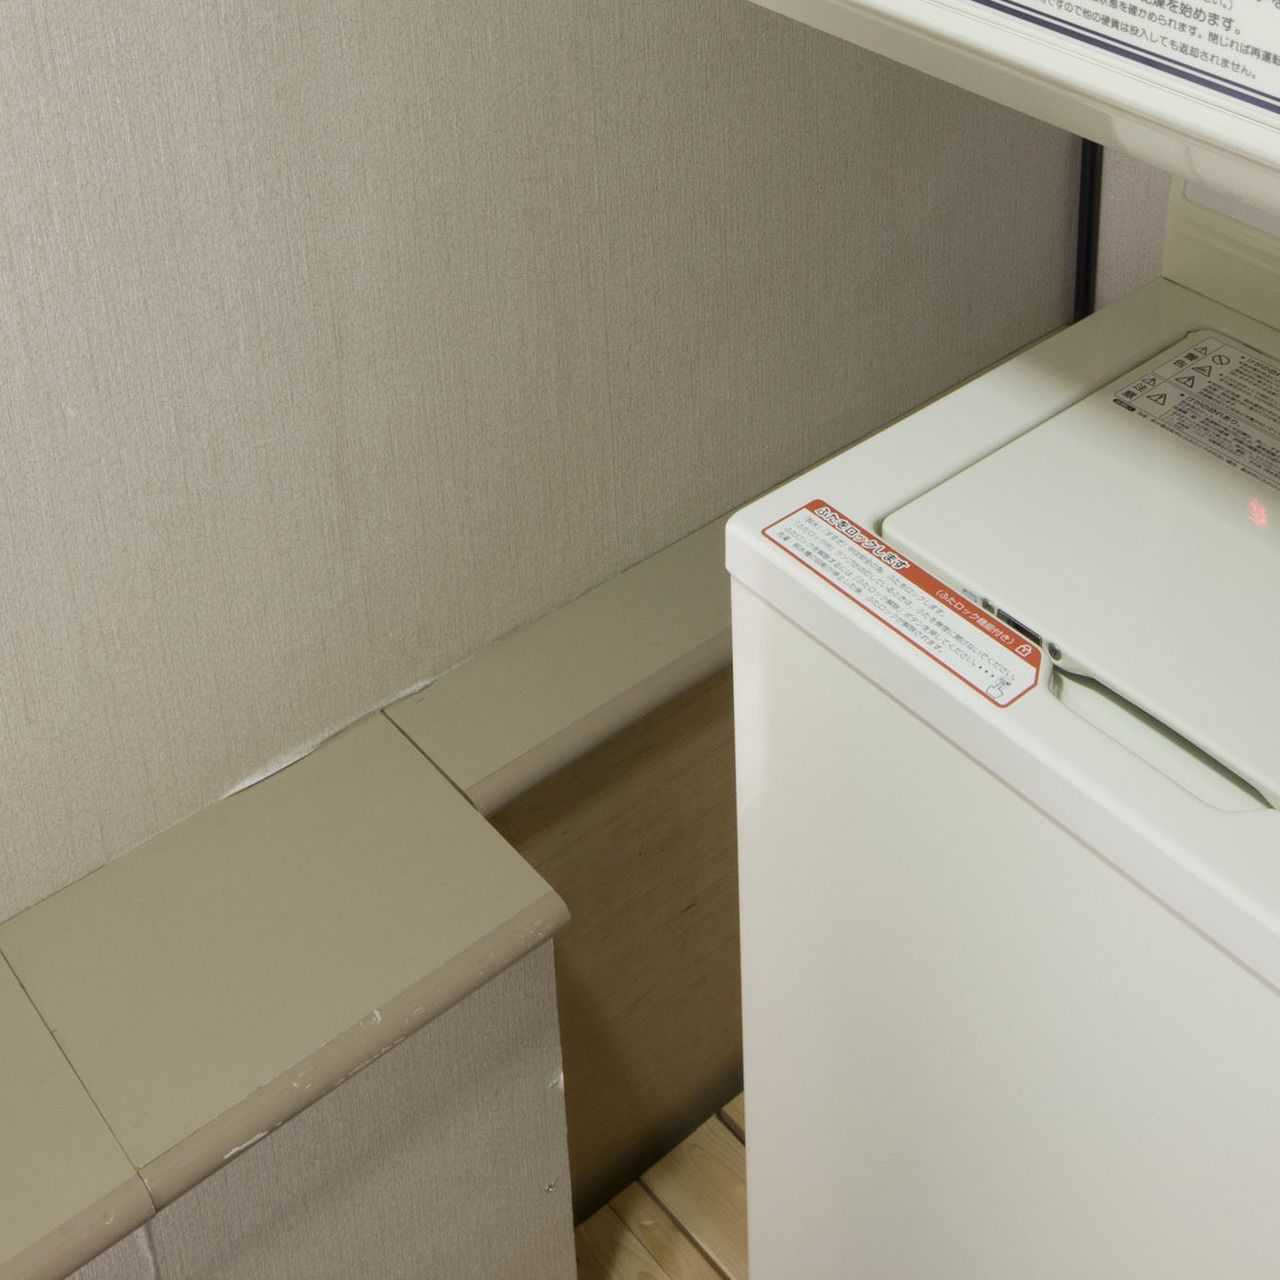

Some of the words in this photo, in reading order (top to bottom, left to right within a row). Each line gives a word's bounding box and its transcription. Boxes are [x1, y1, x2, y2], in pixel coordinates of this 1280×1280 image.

[815, 506, 908, 570] ふたをロックします
